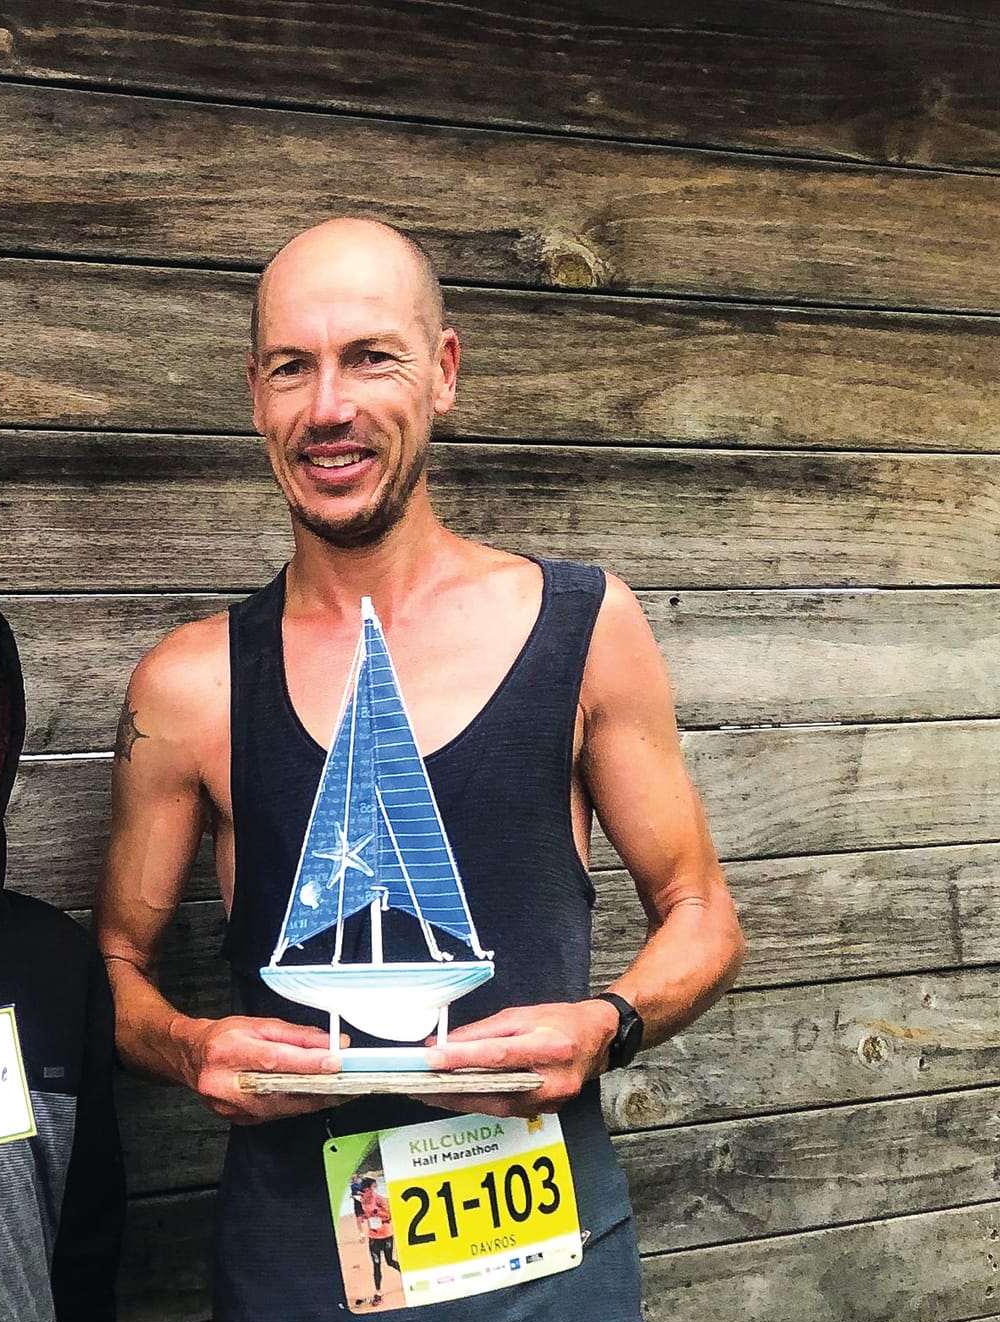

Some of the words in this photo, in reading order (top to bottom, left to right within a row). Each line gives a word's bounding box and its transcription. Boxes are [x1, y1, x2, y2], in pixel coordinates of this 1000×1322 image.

[408, 1123, 505, 1154] KILCUNDA
[412, 1154, 438, 1168] Half
[442, 1142, 499, 1164] Marathon
[400, 1155, 561, 1247] 21-103
[470, 1233, 518, 1257] DAVROS
